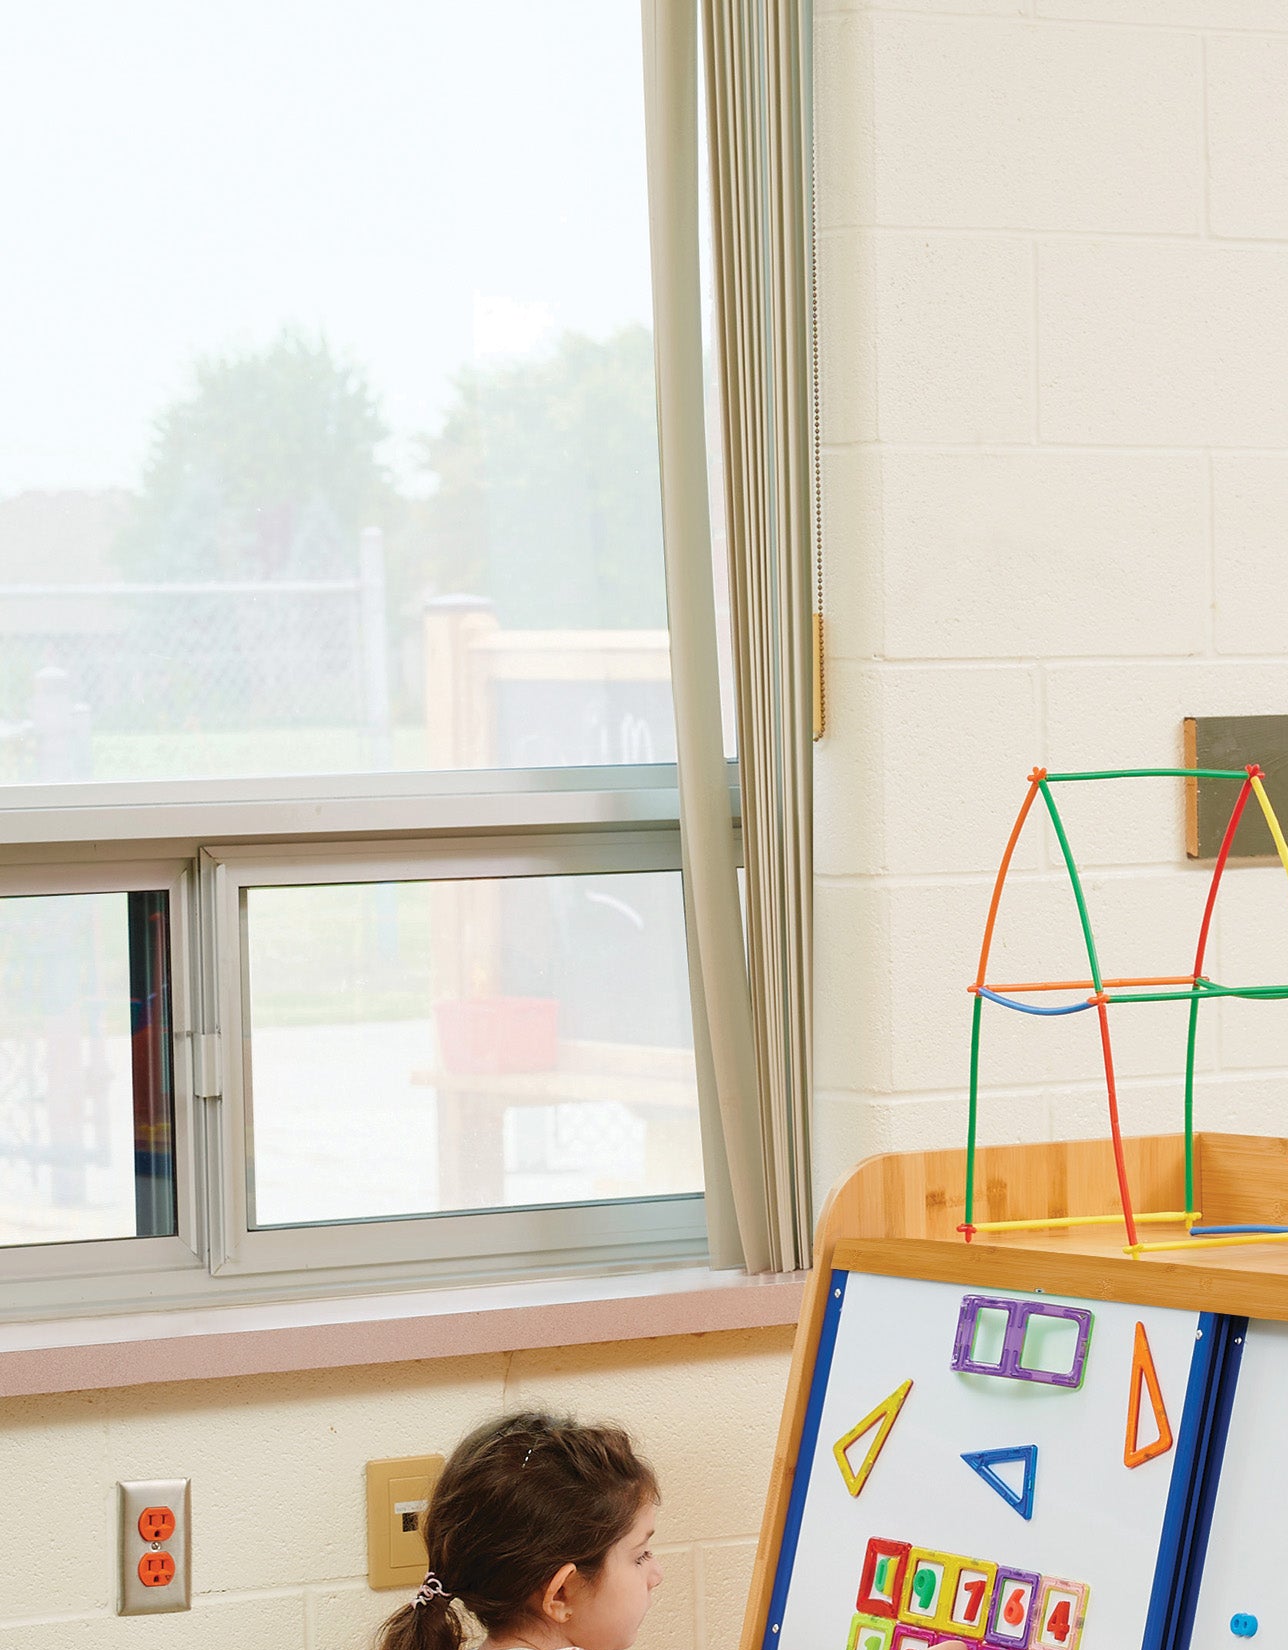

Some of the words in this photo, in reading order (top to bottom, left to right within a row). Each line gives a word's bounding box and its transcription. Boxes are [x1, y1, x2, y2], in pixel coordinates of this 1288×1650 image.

[913, 1568, 936, 1609] 9
[1003, 1588, 1025, 1626] 6
[1047, 1600, 1070, 1643] 4
